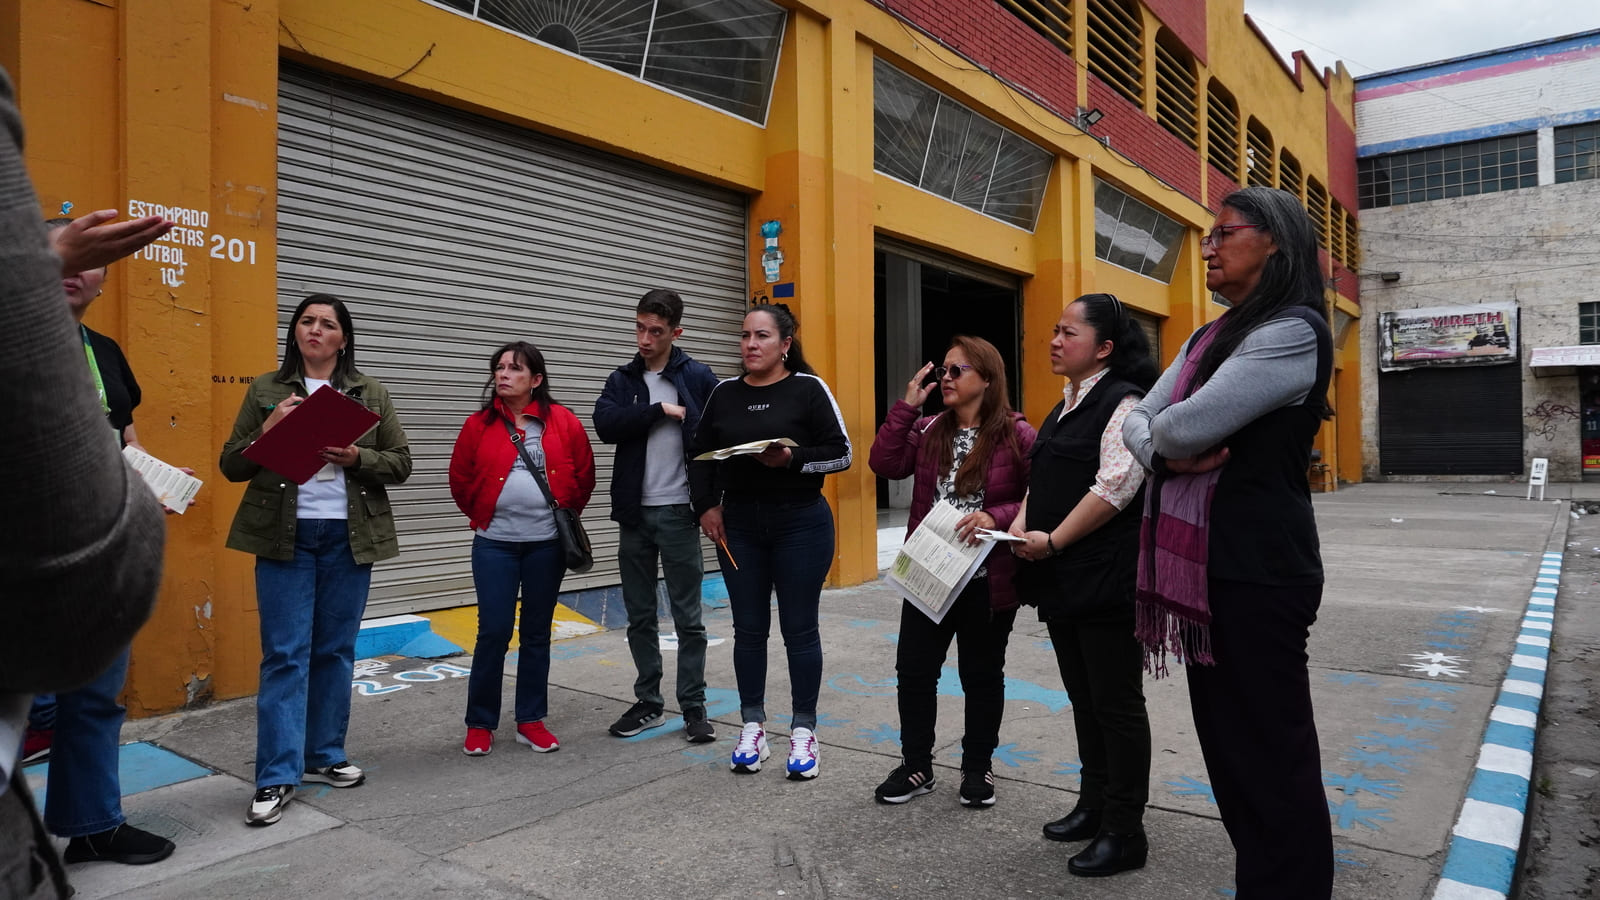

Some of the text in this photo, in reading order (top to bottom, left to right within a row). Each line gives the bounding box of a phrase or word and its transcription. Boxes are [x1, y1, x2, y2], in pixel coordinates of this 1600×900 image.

[128, 199, 209, 228] ESTAMPADO
[209, 234, 256, 265] 201
[1431, 311, 1503, 326] YIRETH
